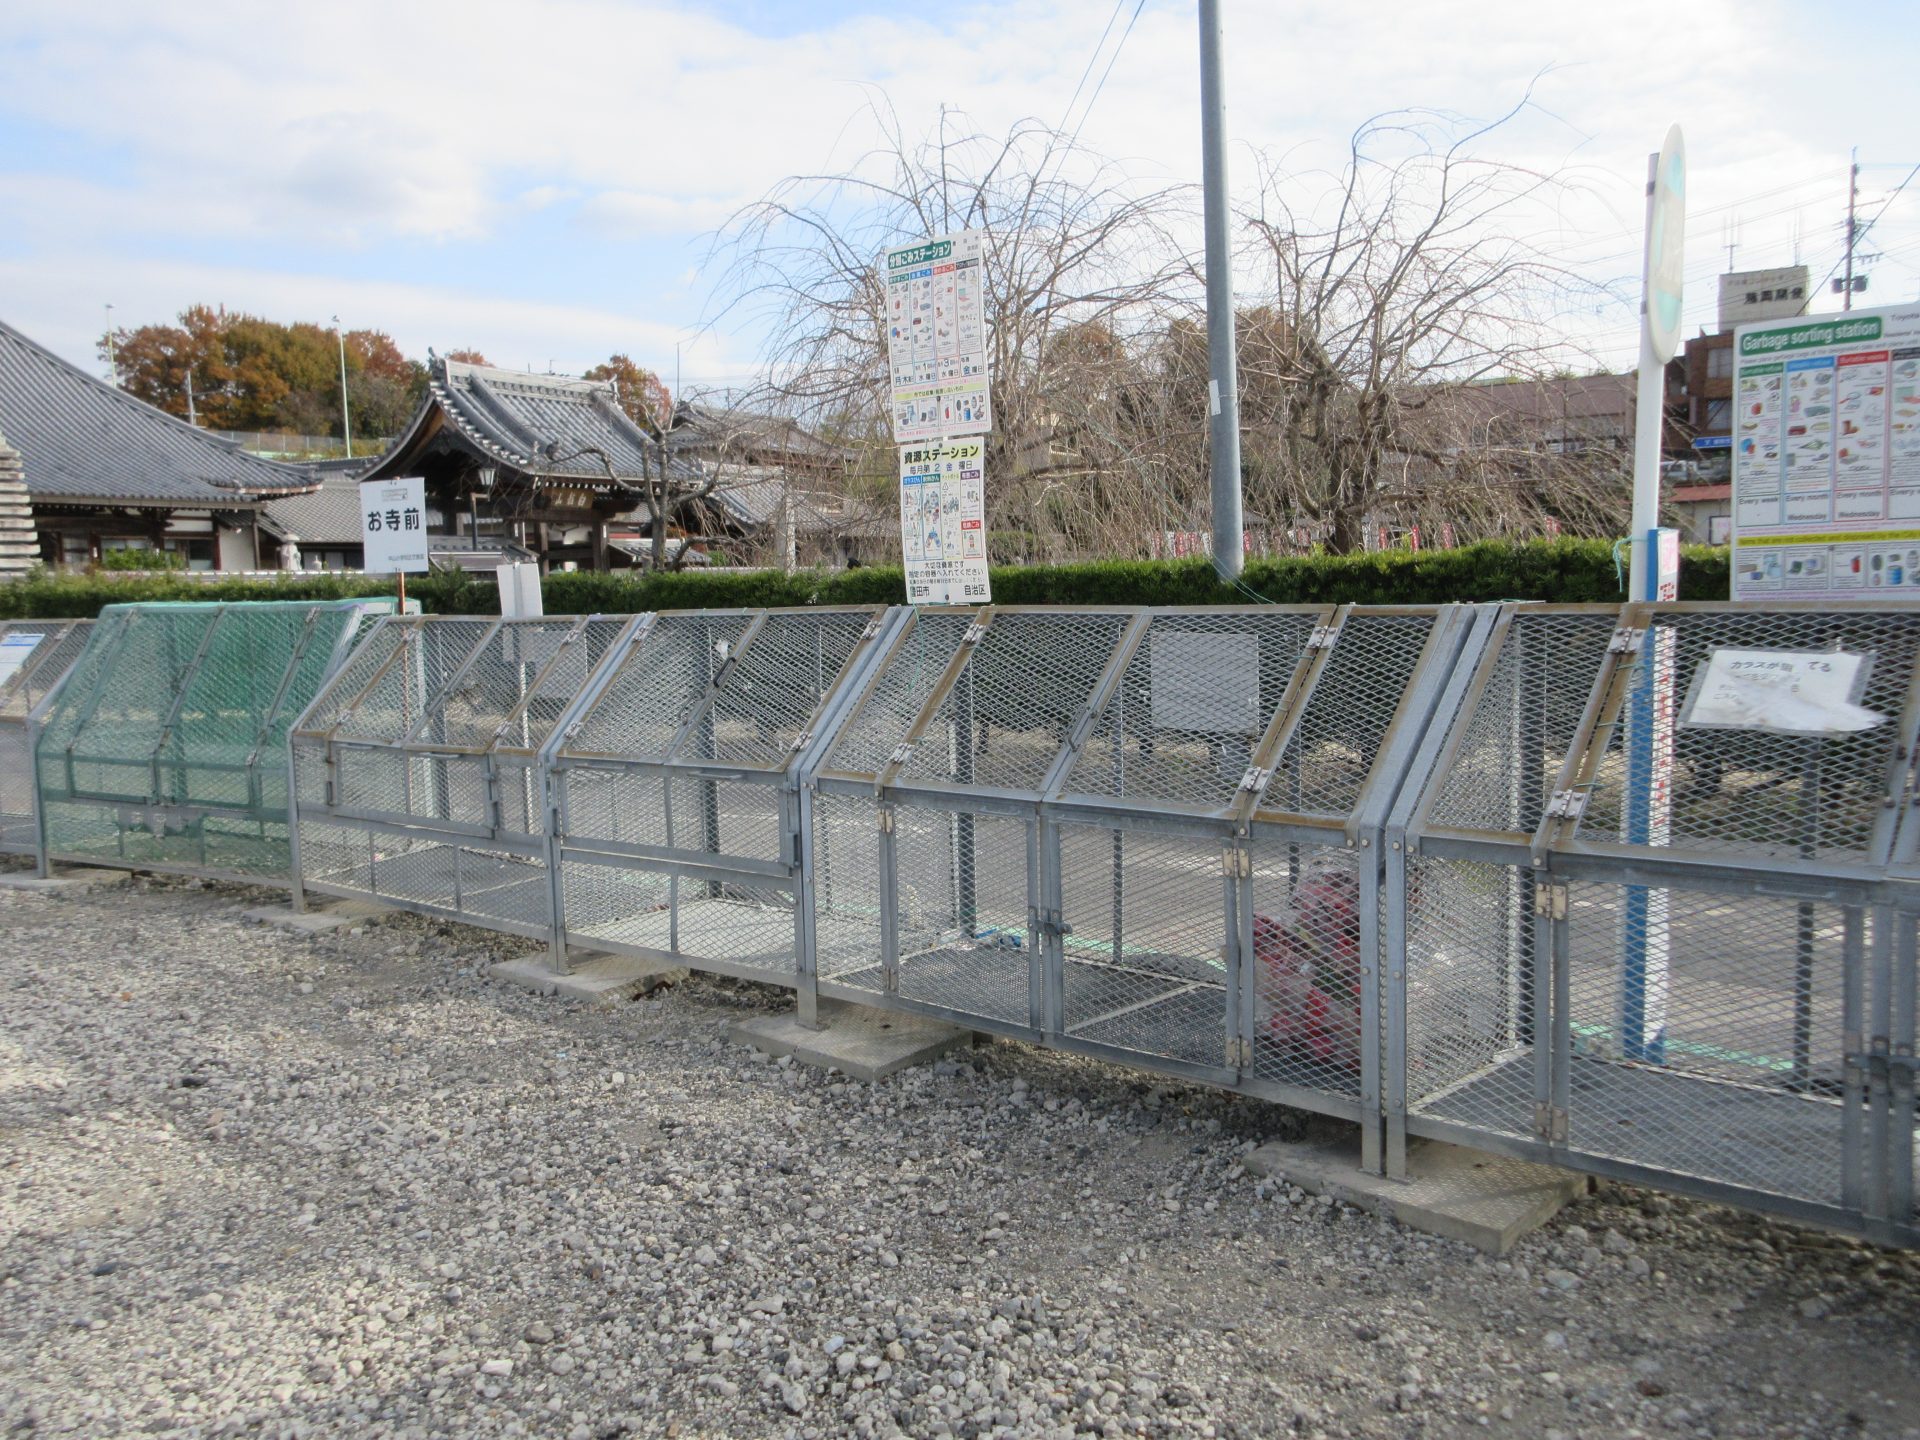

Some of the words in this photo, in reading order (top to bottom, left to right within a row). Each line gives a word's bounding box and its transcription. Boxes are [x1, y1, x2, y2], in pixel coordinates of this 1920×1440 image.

[1743, 333, 1788, 351] Garbage
[1791, 327, 1833, 345] sorting
[1835, 320, 1879, 339] station
[904, 445, 979, 465] 資源ステーション
[1837, 491, 1857, 500] Every
[1739, 497, 1759, 506] Every
[367, 507, 420, 532] お寺前
[924, 560, 965, 569] 大切な資源です
[908, 569, 984, 579] 指定の容器へ入れてください
[964, 584, 987, 597] 自治区
